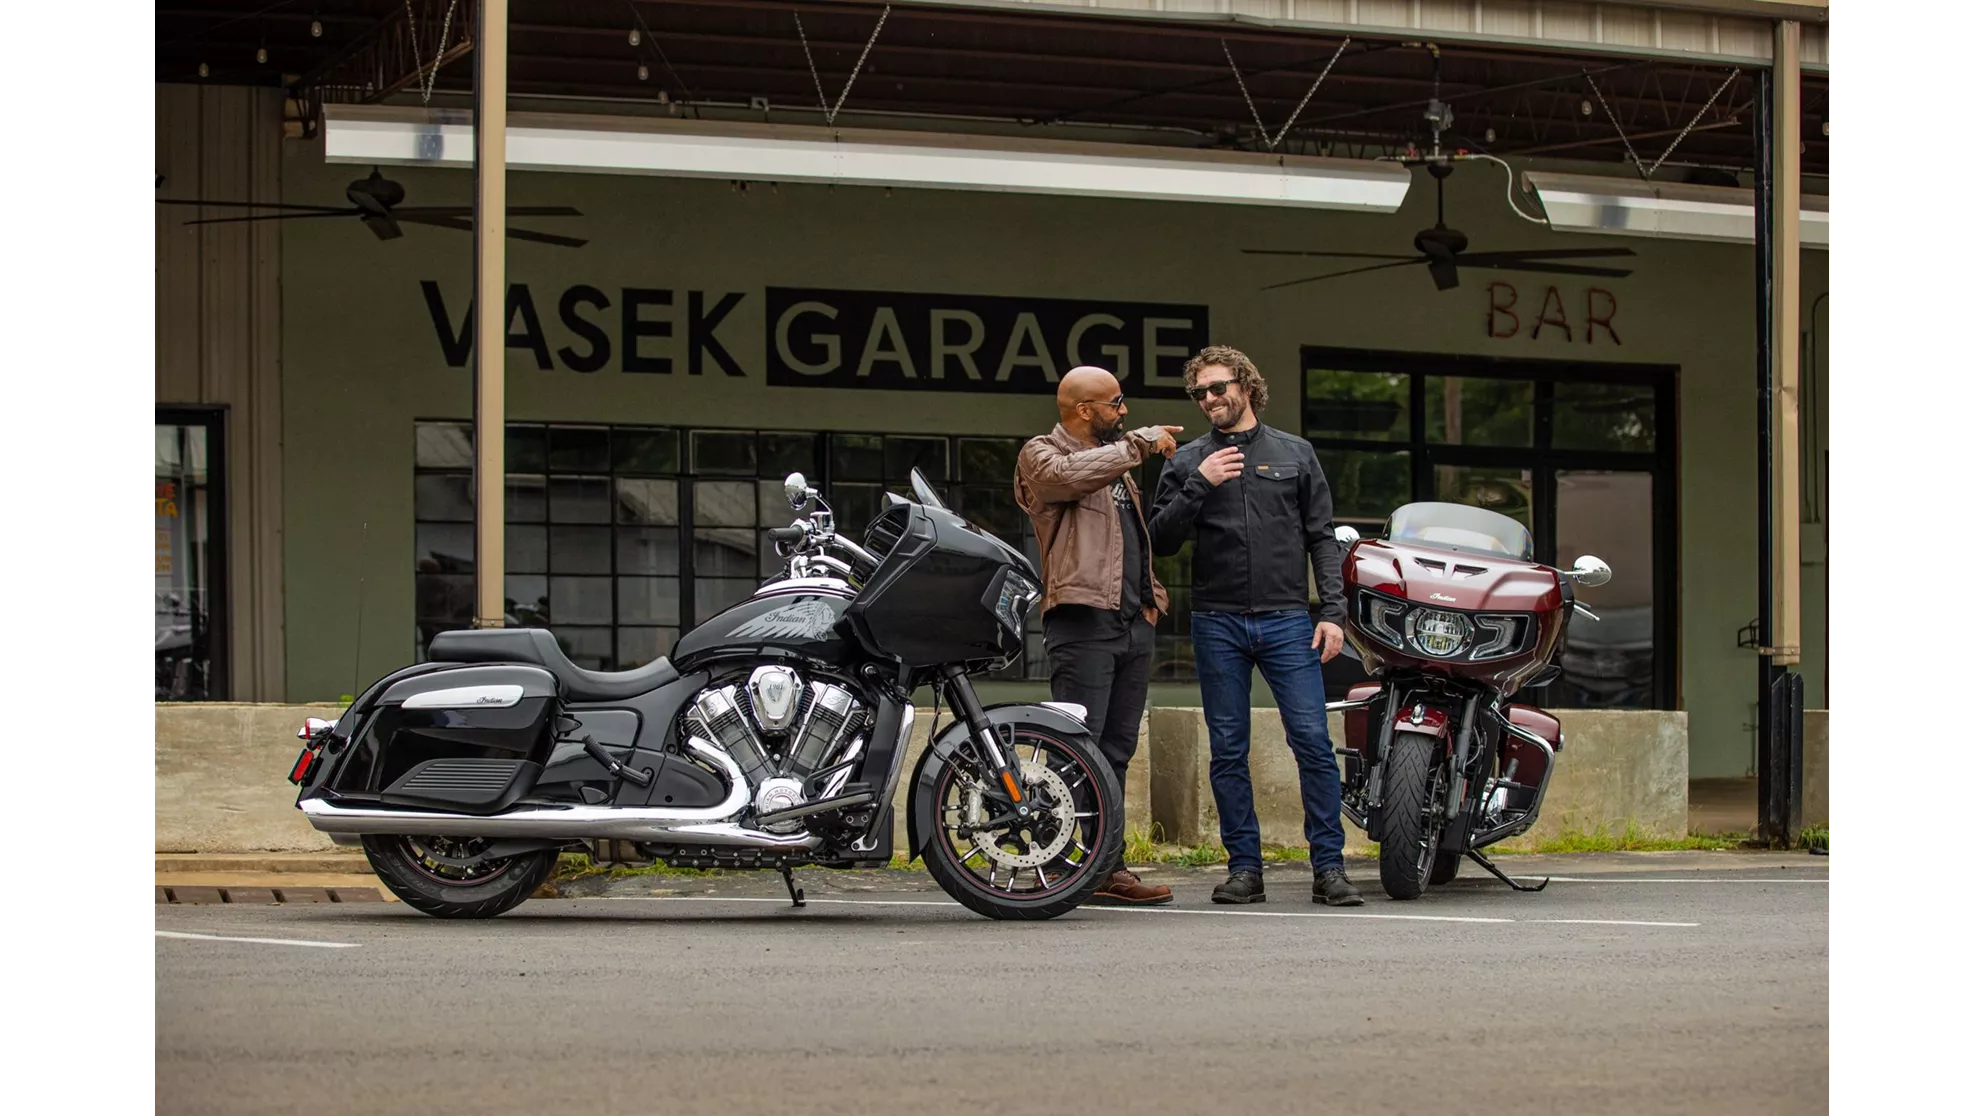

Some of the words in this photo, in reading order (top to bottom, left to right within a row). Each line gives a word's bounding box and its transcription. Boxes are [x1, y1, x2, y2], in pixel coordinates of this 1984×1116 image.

[1486, 281, 1621, 346] BAR
[420, 280, 747, 377] VASEK
[774, 301, 1194, 388] GARAGE
[1429, 592, 1456, 603] Indian
[764, 611, 806, 624] Indian
[476, 696, 503, 704] Indian
